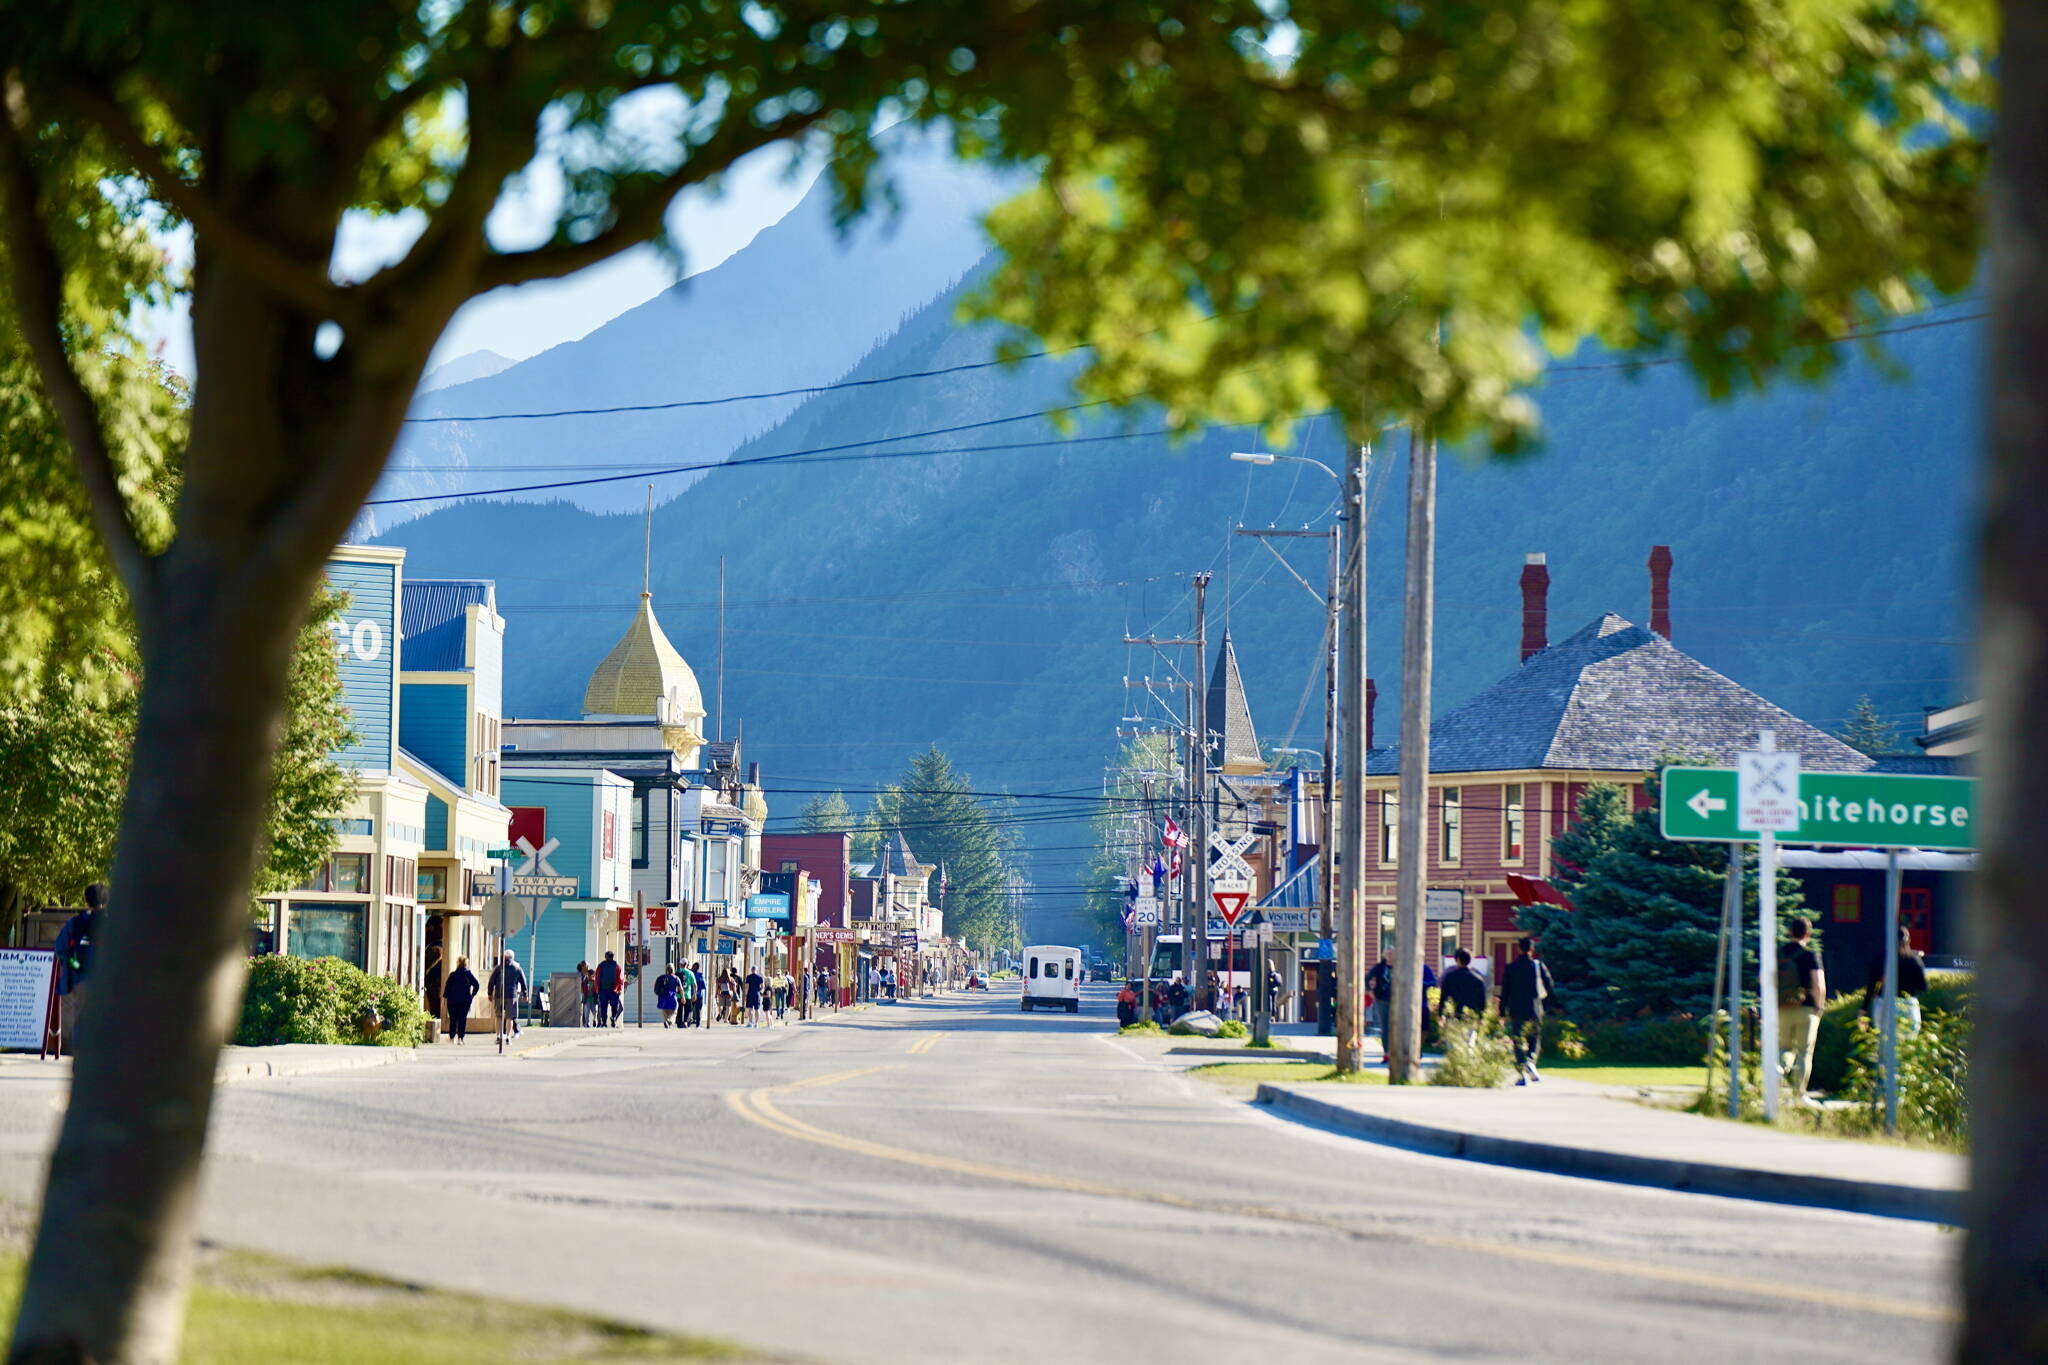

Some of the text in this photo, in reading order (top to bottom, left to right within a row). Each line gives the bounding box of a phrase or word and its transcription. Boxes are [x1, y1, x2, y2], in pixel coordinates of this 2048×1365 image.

[1798, 795, 1969, 827] itehorse
[1210, 834, 1253, 876] CROSSING
[514, 877, 558, 885] AGWAY
[477, 885, 575, 896] TRDING CO
[1138, 912, 1155, 922] 20
[1268, 912, 1299, 920] VISITOR
[858, 922, 896, 931] PANTHEON
[835, 932, 854, 940] GEMS
[24, 953, 53, 962] Tours
